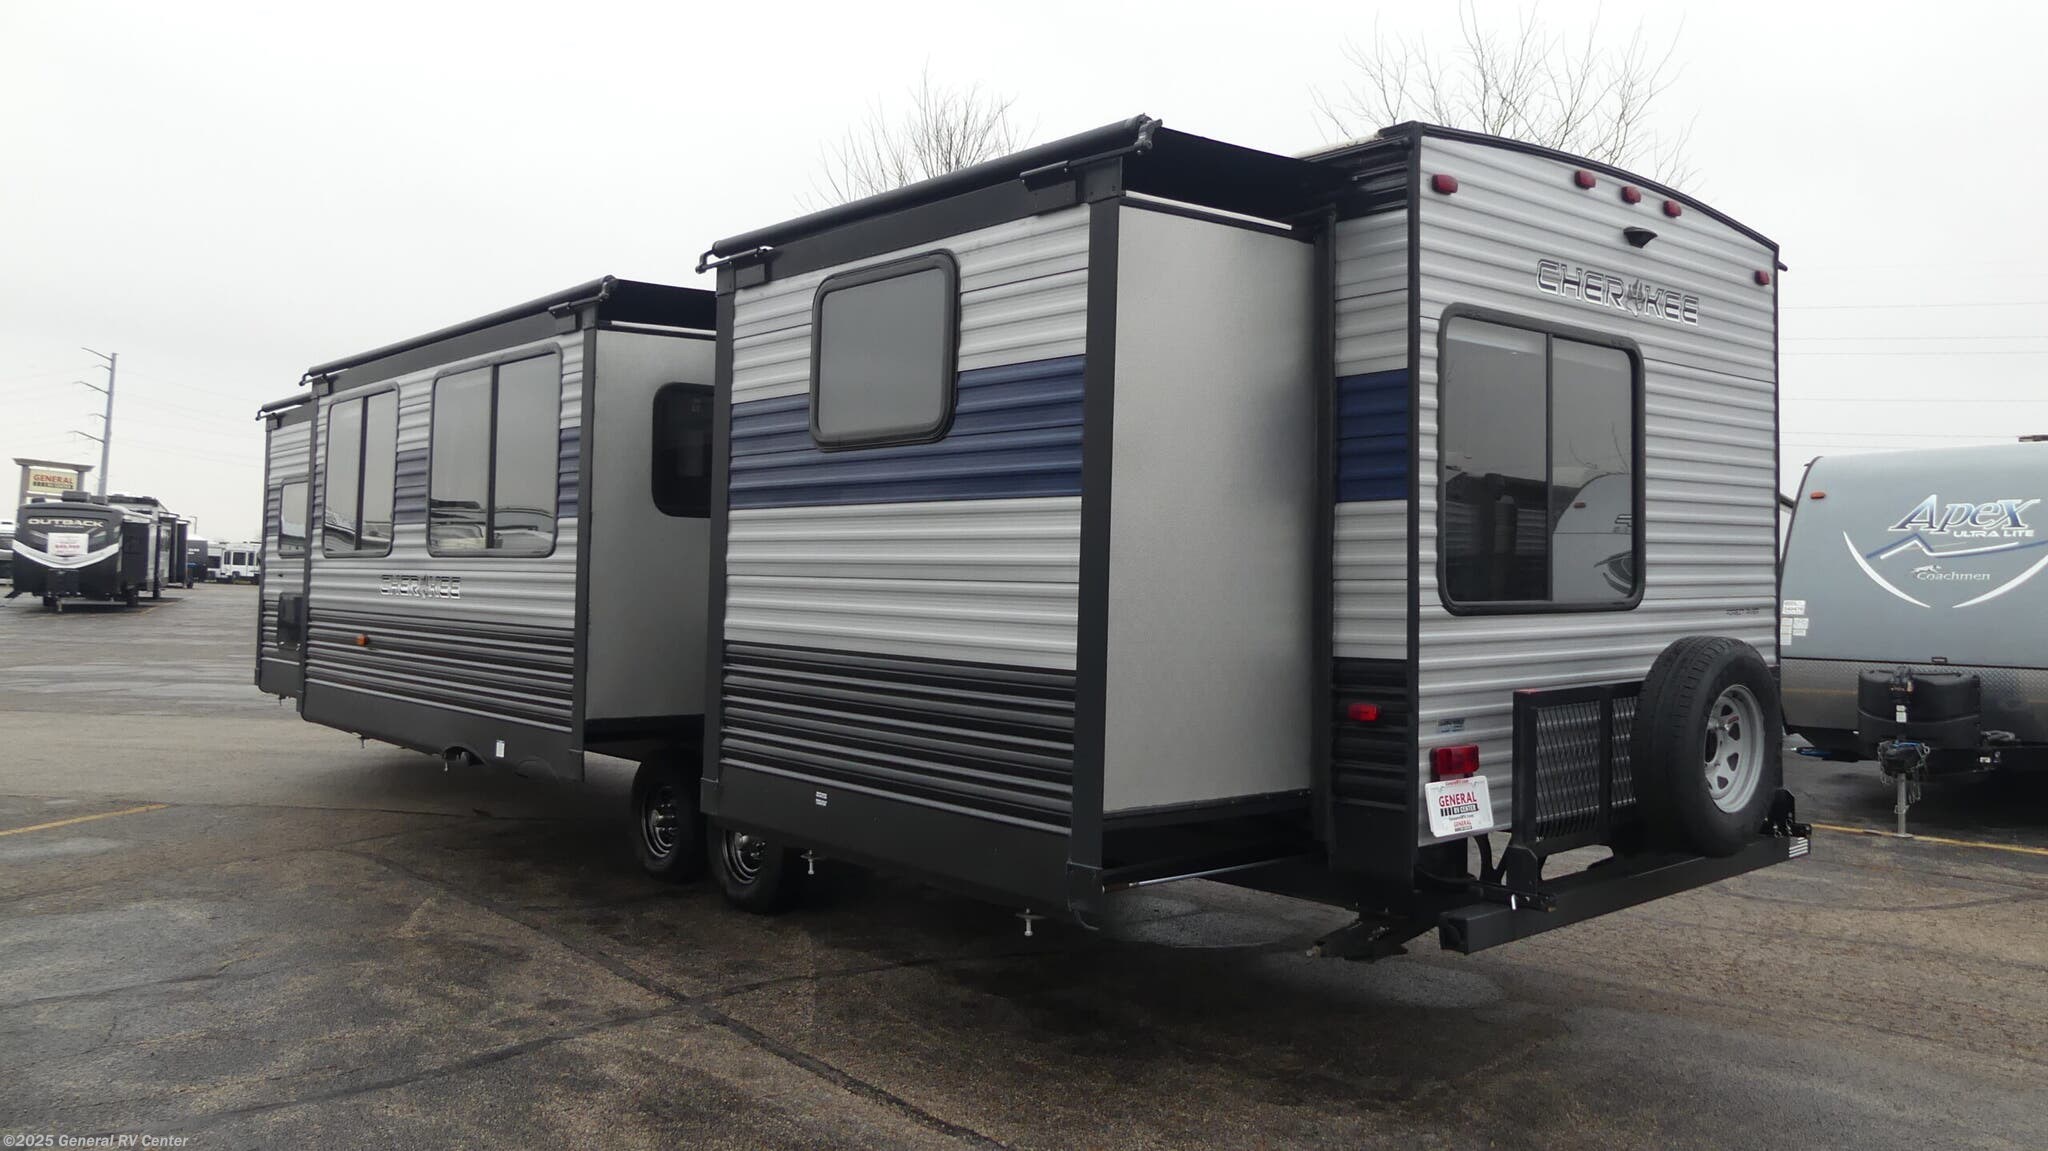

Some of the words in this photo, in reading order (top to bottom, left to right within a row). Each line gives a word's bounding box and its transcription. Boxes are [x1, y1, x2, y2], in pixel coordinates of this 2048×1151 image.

[33, 474, 73, 484] GENERAL
[28, 518, 104, 528] OUTBACK
[1953, 530, 2001, 538] ULTRA
[2003, 529, 2035, 537] LITE
[1916, 571, 1991, 581] Coachmen
[1438, 791, 1477, 807] GENERAL
